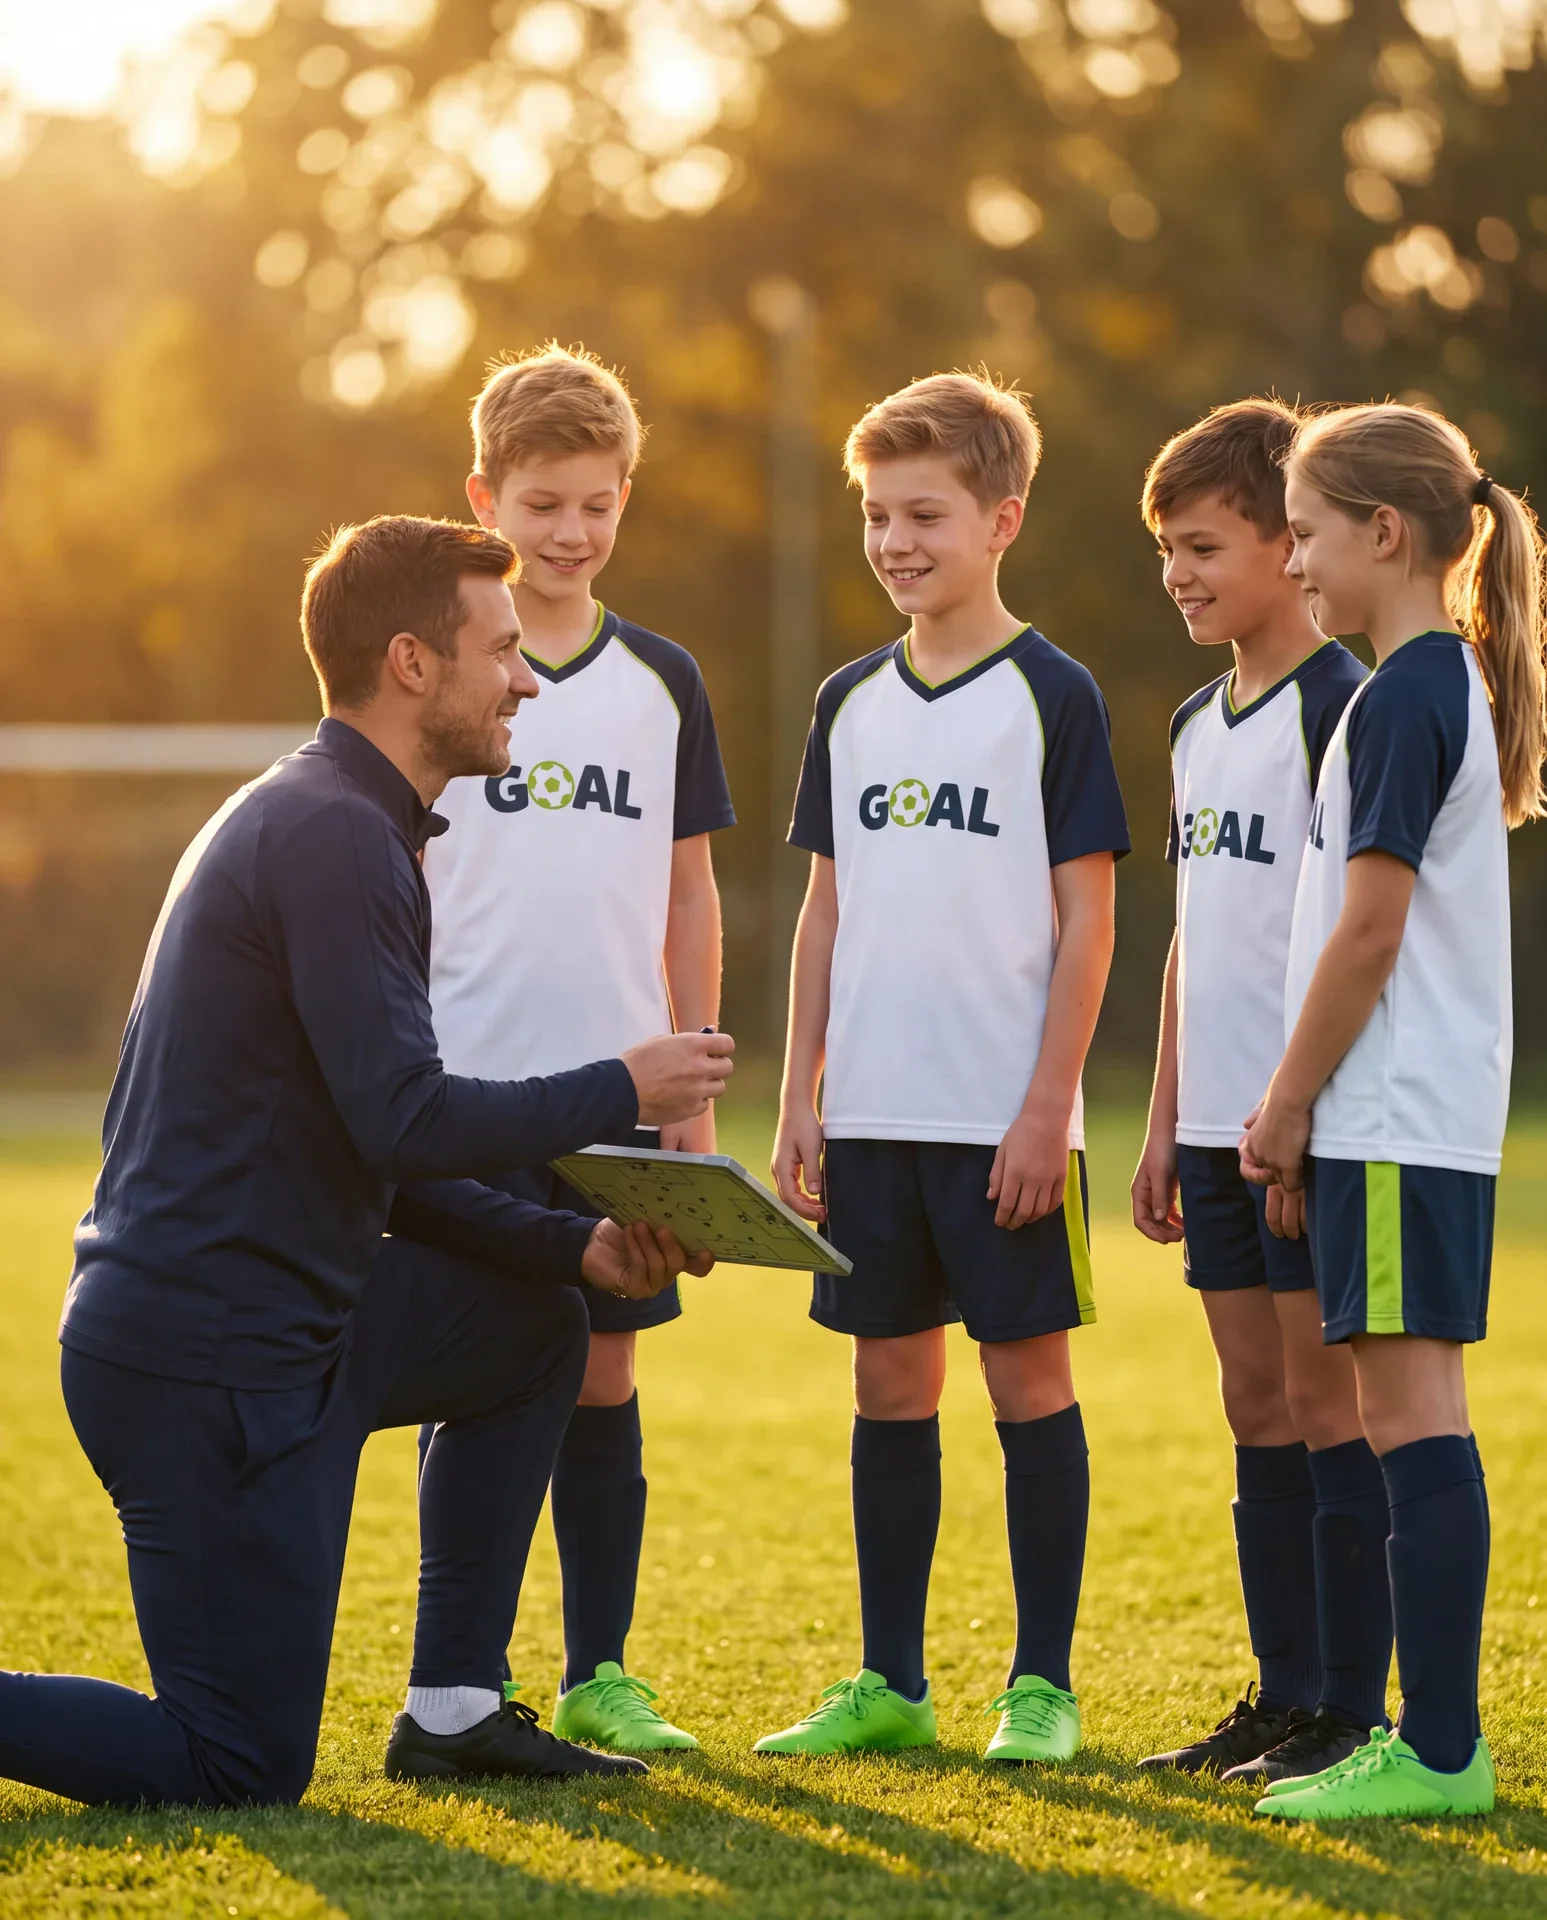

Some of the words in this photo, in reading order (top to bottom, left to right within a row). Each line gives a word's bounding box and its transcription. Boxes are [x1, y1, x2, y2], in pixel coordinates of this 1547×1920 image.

[484, 760, 642, 820] GOAL
[859, 778, 1000, 837] GOAL
[1181, 807, 1276, 865] GOAL
